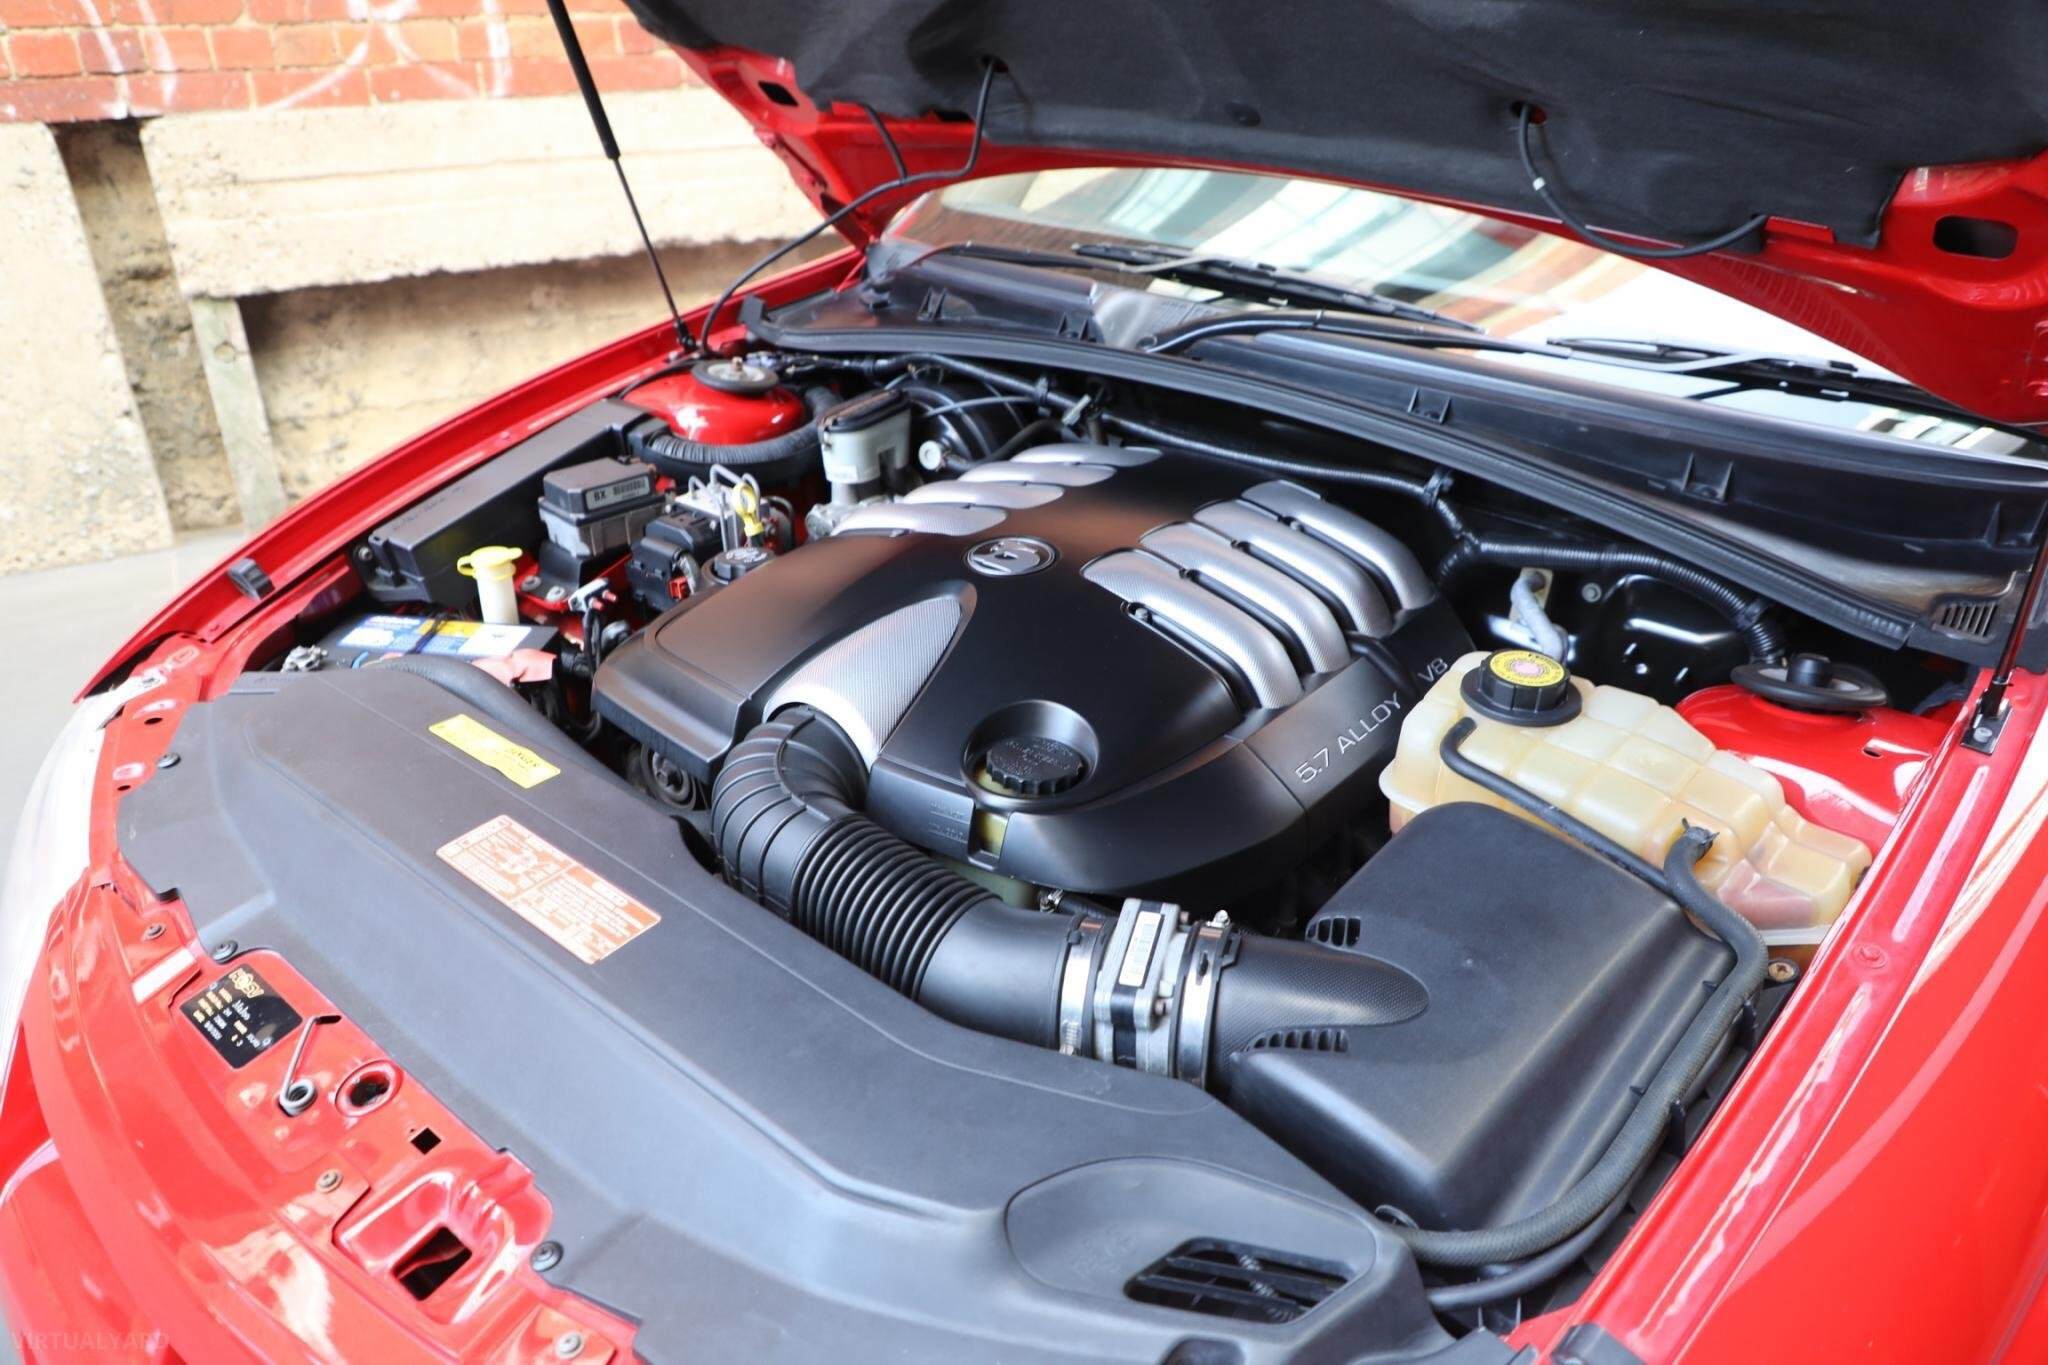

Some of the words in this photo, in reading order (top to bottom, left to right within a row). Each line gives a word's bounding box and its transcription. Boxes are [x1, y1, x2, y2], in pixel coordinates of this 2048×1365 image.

[1295, 747, 1330, 783] 5.7
[1337, 692, 1401, 754] ALLOY
[1417, 657, 1449, 683] V8
